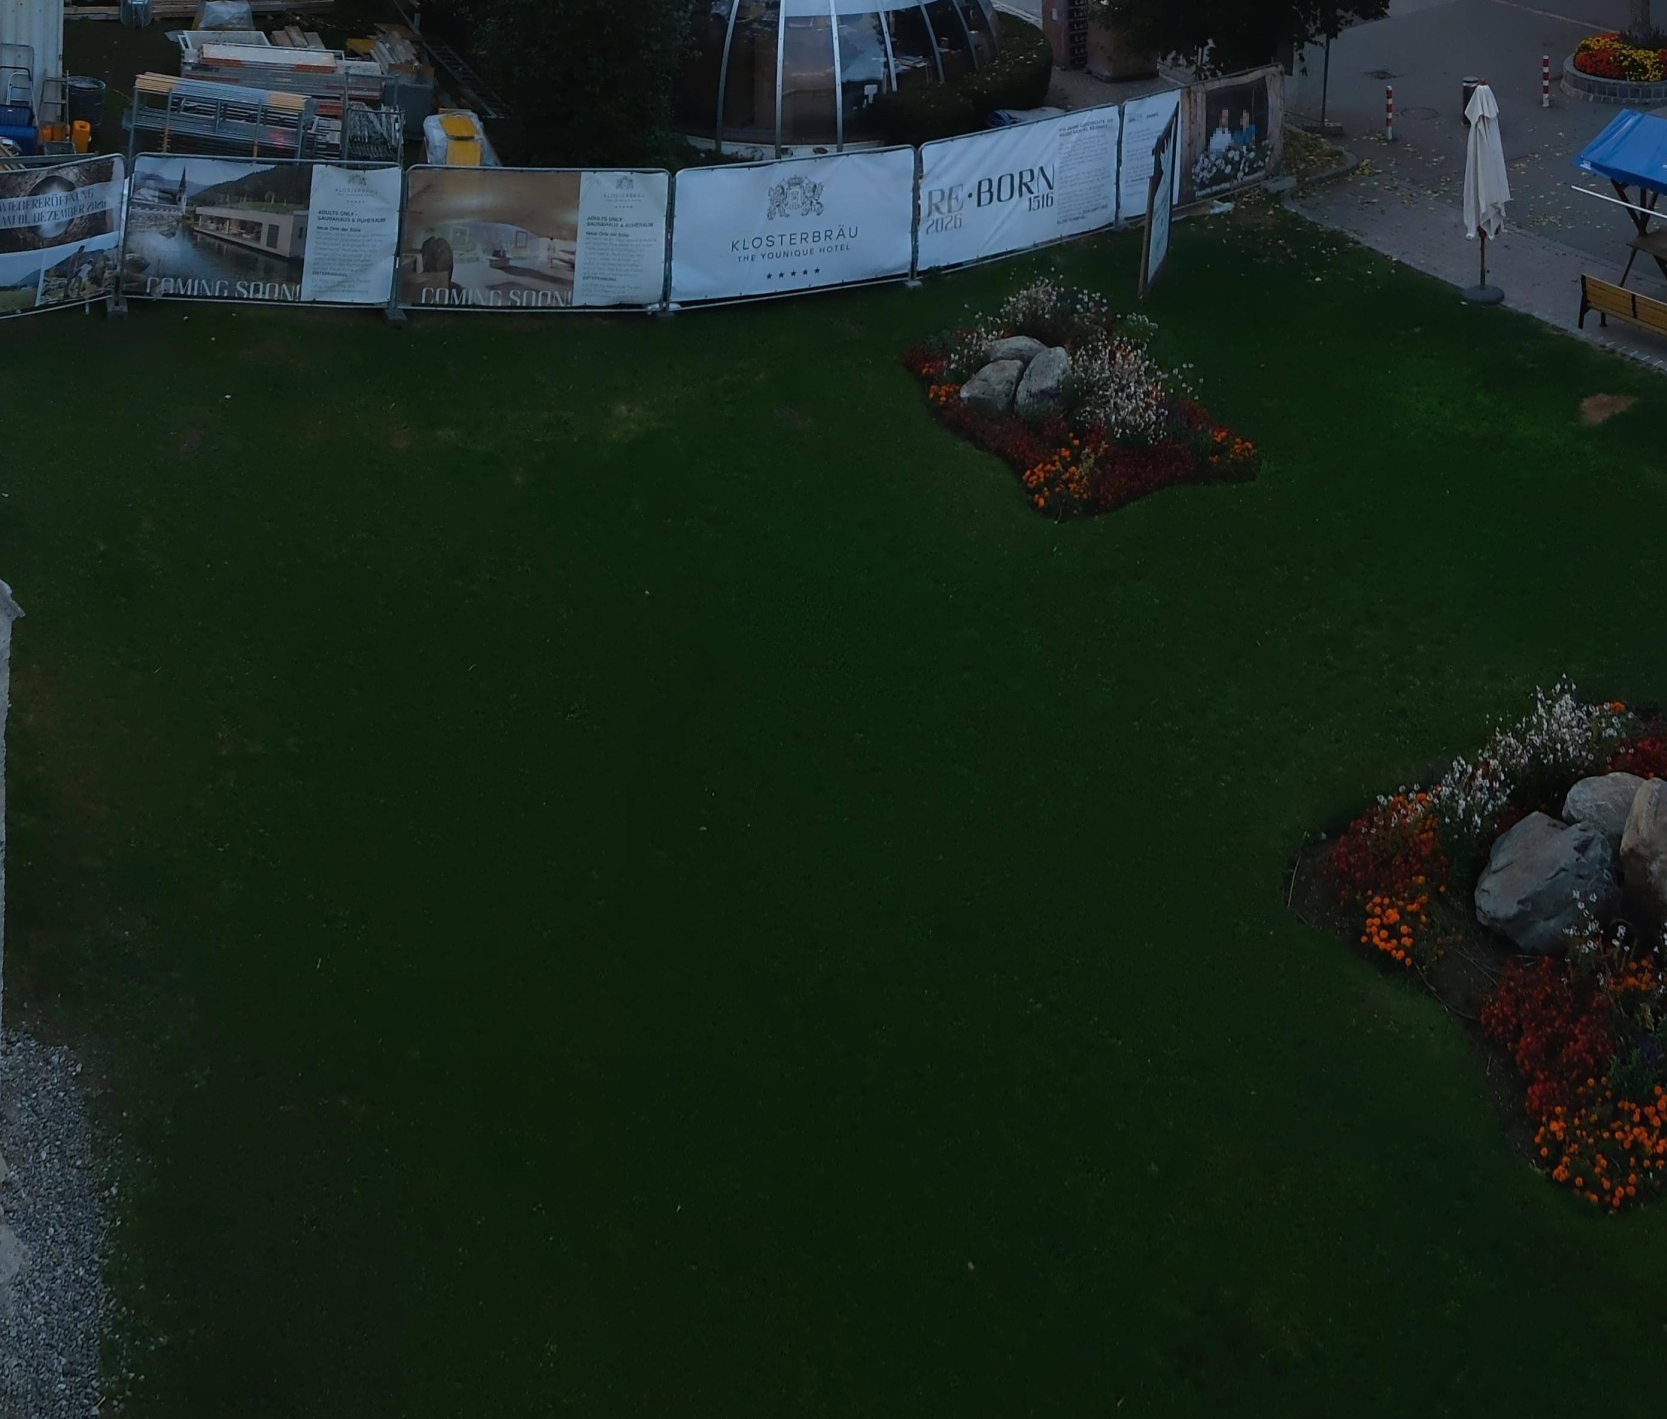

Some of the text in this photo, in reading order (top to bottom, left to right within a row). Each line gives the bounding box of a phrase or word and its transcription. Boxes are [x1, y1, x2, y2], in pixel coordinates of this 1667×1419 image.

[1028, 192, 1054, 212] 1516
[925, 214, 962, 235] 2026
[731, 224, 858, 252] KLOSTERBRÄU
[738, 243, 850, 263] THE YOUNIQUE HOTEL
